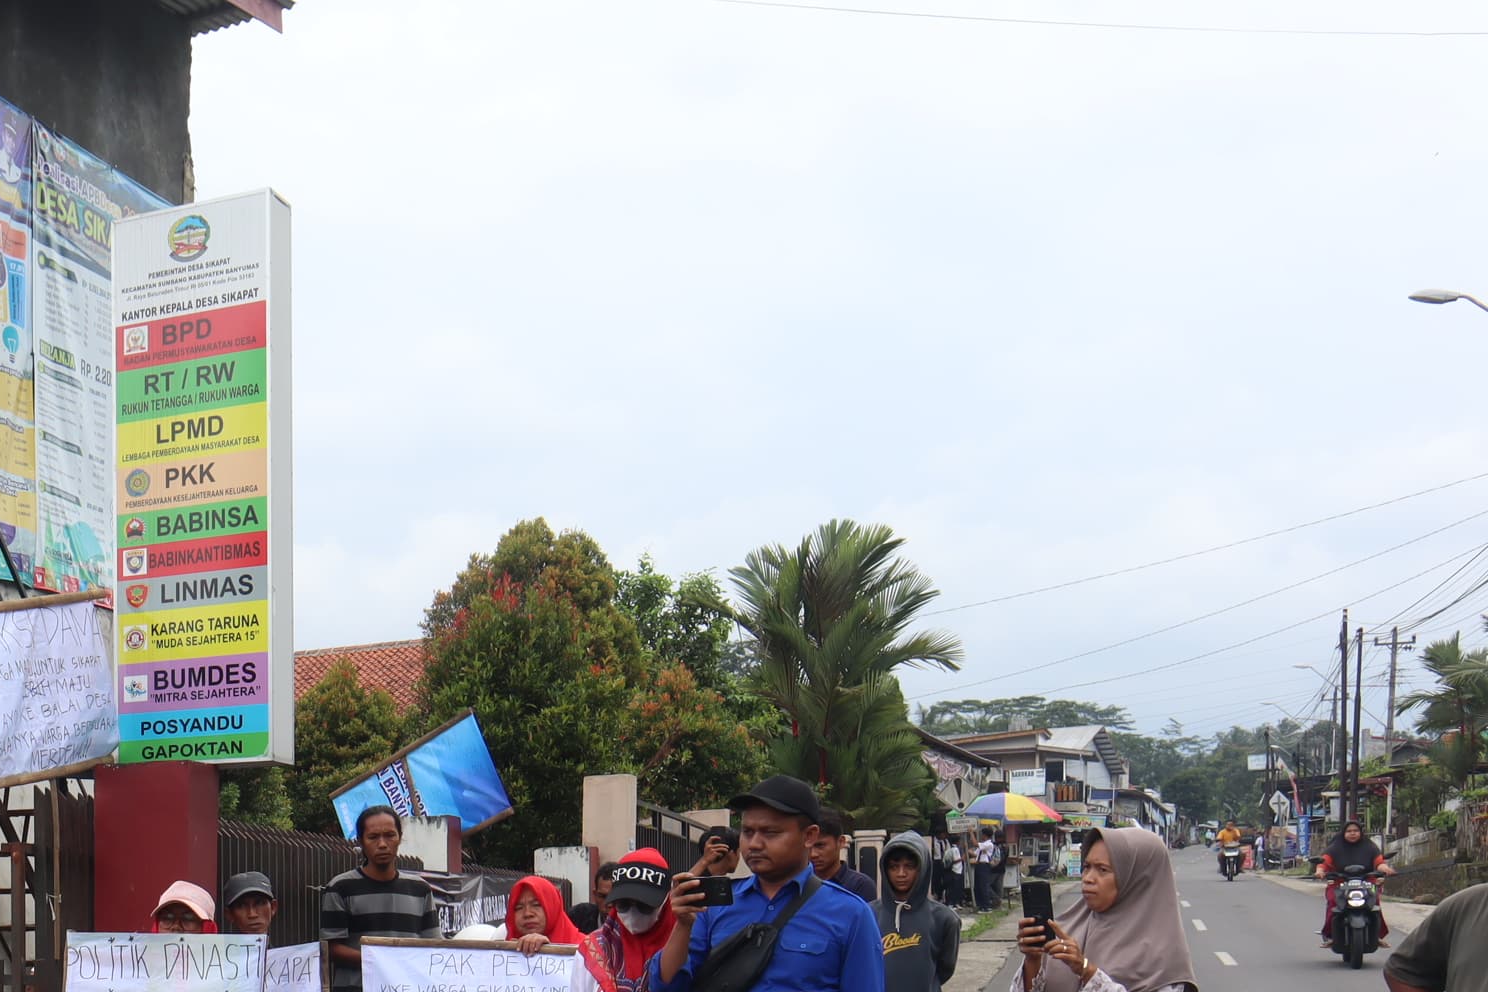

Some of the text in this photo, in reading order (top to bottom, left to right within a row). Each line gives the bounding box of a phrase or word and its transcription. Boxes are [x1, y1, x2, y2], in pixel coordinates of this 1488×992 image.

[36, 181, 81, 234] DESA
[121, 282, 157, 294] KECAMATAN
[158, 277, 187, 289] SUMBANG
[188, 270, 224, 281] KABUPATEN
[225, 263, 260, 275] BANYUMAS
[148, 257, 231, 280] PEMERINTAH DESA SIKAPAT
[121, 288, 259, 323] KANTOR KEPALA DESA SIKAPAT
[162, 318, 212, 346] BPD
[123, 353, 152, 366] BADAN
[235, 335, 257, 347] DESA
[144, 360, 236, 395] RT / RW
[121, 399, 149, 417] RUKUN
[150, 392, 193, 411] TETANGGA
[199, 388, 227, 404] RUKUN
[229, 383, 260, 398] WARGA
[156, 415, 224, 445] LPMD
[122, 435, 260, 463] LEMBAGA PEMBERDAYAAN MASYARAKAT DESA
[165, 462, 216, 489] PKK
[125, 484, 259, 509] PEMBERDAYAAN KESEJAHTERAAN KELUARGA
[156, 504, 259, 537] BABINSA
[149, 540, 261, 569] BABINKANTIBMAS
[160, 574, 254, 604] LINMAS
[151, 614, 259, 637] KARANG TARUNA
[151, 637, 184, 650] "MUDA
[185, 632, 243, 647] SEJAHTERA
[71, 655, 102, 670] SIKAPAT
[153, 661, 257, 691] BUMDES
[55, 674, 91, 695] MAJU
[150, 685, 261, 704] "MITRA SEJAHTERA"
[40, 698, 82, 719] BALAI
[140, 714, 244, 736] POSYANDU
[141, 740, 243, 760] GAPOKTAN
[612, 866, 666, 886] SPORT
[66, 936, 263, 982] POLITIK DINASTI
[428, 952, 475, 977] PAK
